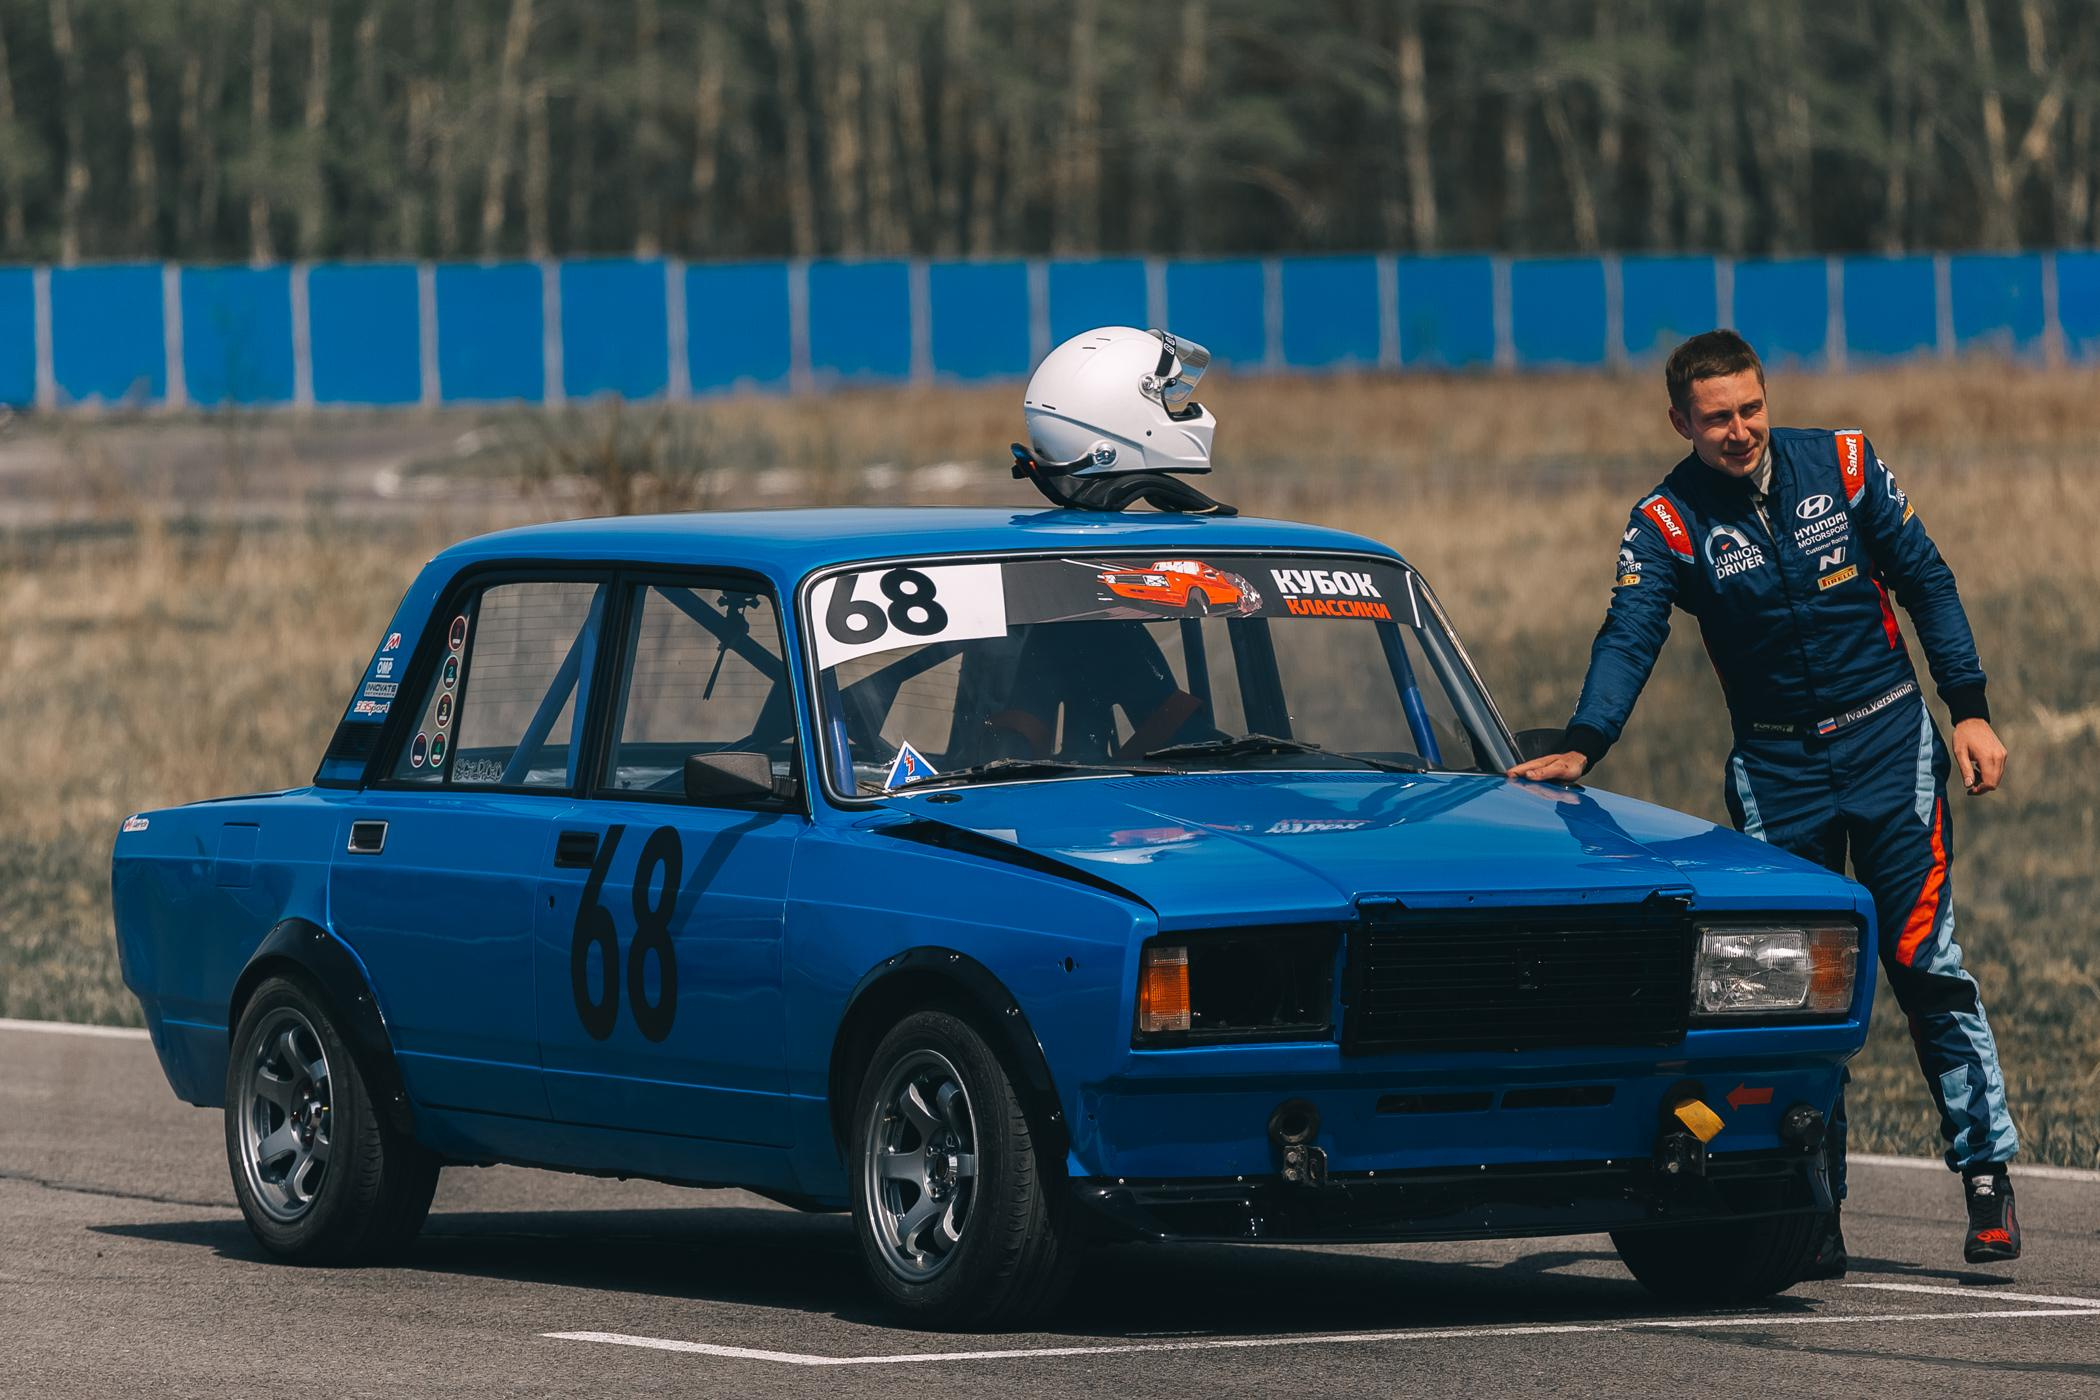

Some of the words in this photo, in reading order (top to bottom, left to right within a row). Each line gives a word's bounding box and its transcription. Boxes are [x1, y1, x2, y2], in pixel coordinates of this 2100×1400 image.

[1845, 436, 1858, 477] Sabelt
[1652, 503, 1683, 537] Sabelt
[1794, 511, 1848, 541] HYUNDAI
[1797, 522, 1849, 549] MOTORSPORT
[1805, 541, 1831, 556] Customer
[1831, 534, 1849, 546] Racing
[1715, 544, 1761, 569] JUNIOR
[1716, 554, 1765, 580] DRIVER
[1270, 569, 1382, 598] КУБОК
[825, 568, 949, 645] 68
[1285, 599, 1392, 620] КЛАССИКИ
[1845, 707, 1869, 723] Ivan
[1870, 681, 1913, 713] Vershinin
[570, 823, 683, 1044] 68
